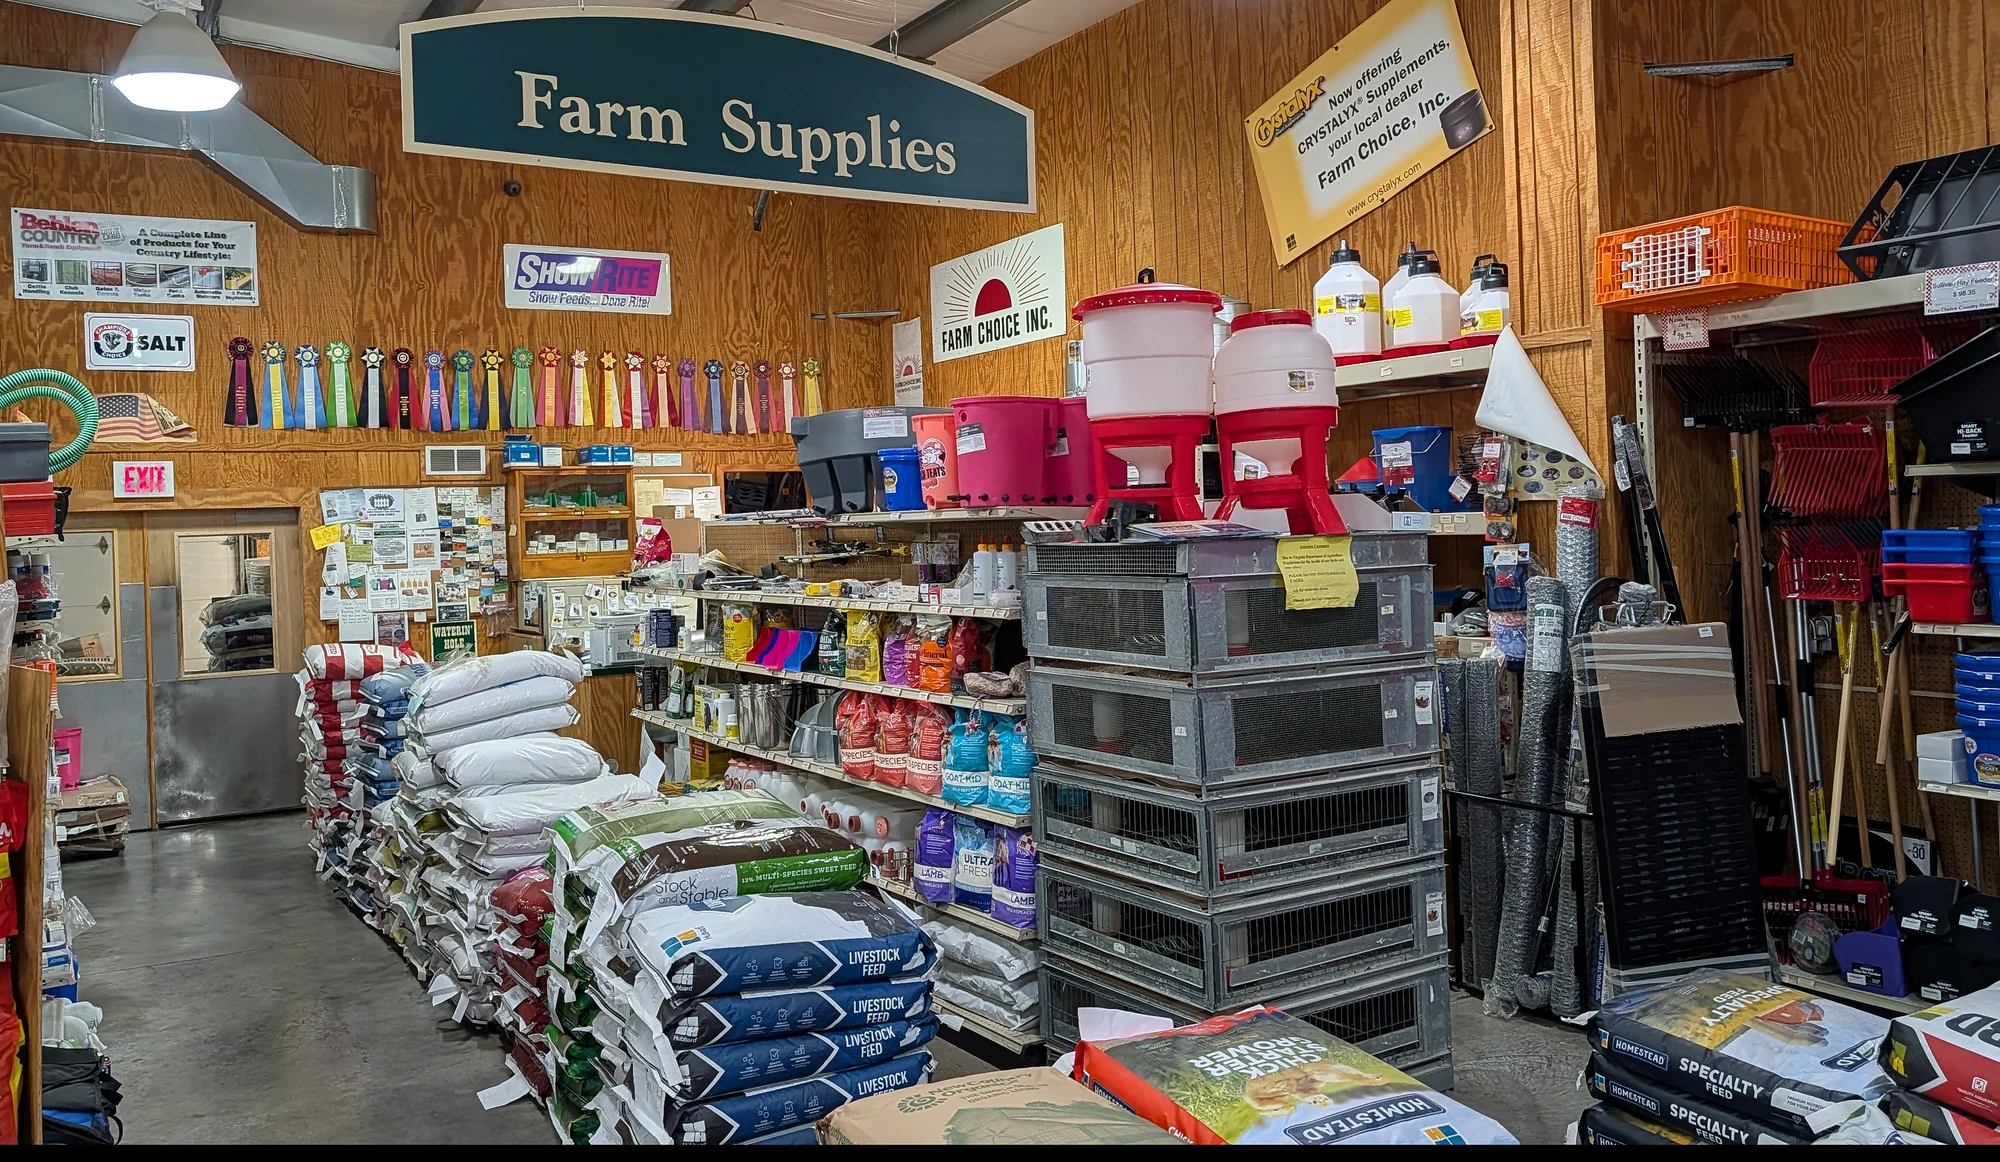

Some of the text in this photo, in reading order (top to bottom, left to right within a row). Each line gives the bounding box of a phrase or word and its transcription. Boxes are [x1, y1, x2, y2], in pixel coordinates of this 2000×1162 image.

[1328, 47, 1403, 111] Now offering
[1366, 39, 1450, 105] Supplements,
[514, 70, 957, 178] Farm Supplies
[1327, 78, 1425, 158] your local dealer
[1317, 90, 1451, 190] Farm Choice, Inc.
[1346, 161, 1422, 217] www.crystalyx.com
[20, 212, 99, 234] Behlen
[20, 230, 100, 245] COUNTRY
[138, 228, 228, 240] A Complete Line
[143, 239, 192, 248] Products
[194, 240, 210, 249] for
[211, 241, 237, 250] Your
[136, 248, 232, 261] Country Lifestyle:
[1970, 277, 1993, 285] Feeder
[528, 291, 651, 309] Show Feeds... Done Rite!
[942, 305, 1053, 353] FARM CHOICE INC.
[137, 335, 186, 351] SALT
[102, 351, 127, 359] CHOICE
[124, 465, 165, 493] EXIT
[926, 465, 947, 479] TEATS
[434, 624, 473, 638] WATERIN'
[444, 638, 465, 650] HOLE
[945, 773, 982, 783] GOAT KID
[994, 779, 1030, 790] GOAT KID
[964, 854, 993, 866] ULTRA
[741, 863, 857, 883] 12% MULTI-SPECIES SWEET FEED
[921, 867, 944, 879] LAMB
[655, 876, 697, 895] Stock
[658, 886, 729, 905] and Stable
[1010, 893, 1035, 905] LAMB
[849, 947, 901, 965] LIVESTOCK
[862, 964, 886, 977] FEED
[1713, 987, 1747, 1003] FEED
[853, 996, 905, 1014] LIVESTOCK
[1700, 984, 1792, 1027] SPECIALTY
[866, 1012, 890, 1024] FEED
[672, 1035, 698, 1044] Hubbard
[845, 1026, 896, 1047] LIVESTOCK
[861, 1042, 883, 1058] FEED
[1187, 1036, 1313, 1068] GROWER
[1615, 1039, 1664, 1065] HOMESTEAD
[1203, 1042, 1328, 1077] STARTER
[1239, 1053, 1323, 1080] CHICK
[858, 1071, 909, 1096] LIVESTOCK
[1679, 1057, 1764, 1100] SPECIALTY
[942, 1080, 1019, 1097] Organics
[1706, 1081, 1733, 1100] FEED
[1957, 1086, 1974, 1098] QUALITY
[1612, 1084, 1658, 1112] HOMESTEAD
[1302, 1098, 1432, 1142] HOMESTEAD
[1670, 1103, 1750, 1145] SPECIALTY
[1696, 1127, 1723, 1145] FEED
